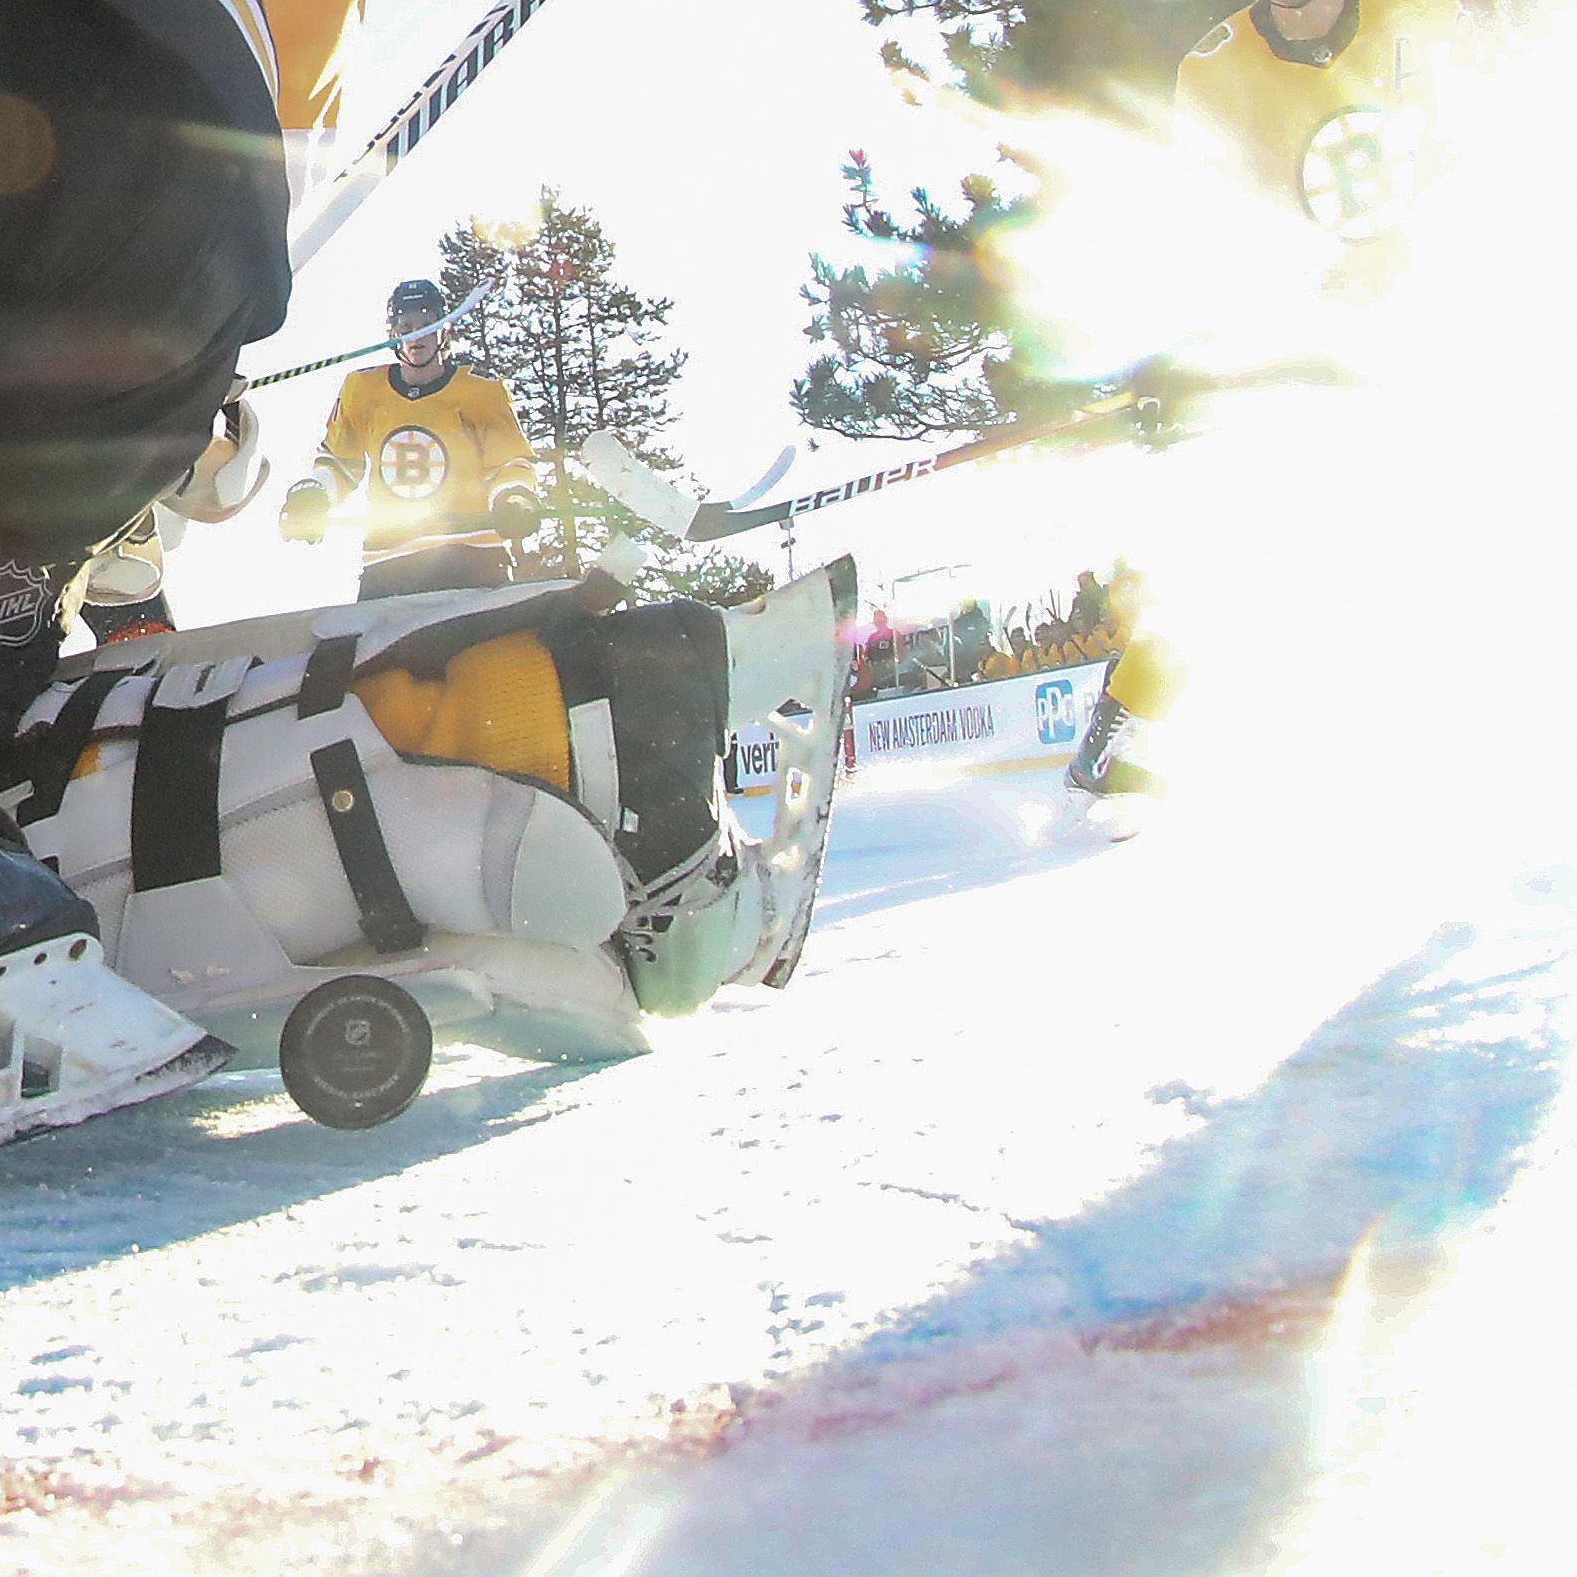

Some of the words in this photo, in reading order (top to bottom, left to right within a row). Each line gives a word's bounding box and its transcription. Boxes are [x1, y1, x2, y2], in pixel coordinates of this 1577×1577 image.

[868, 717, 891, 753] NEW
[892, 706, 958, 749] AMSTERDAM
[959, 704, 995, 741] VODKA
